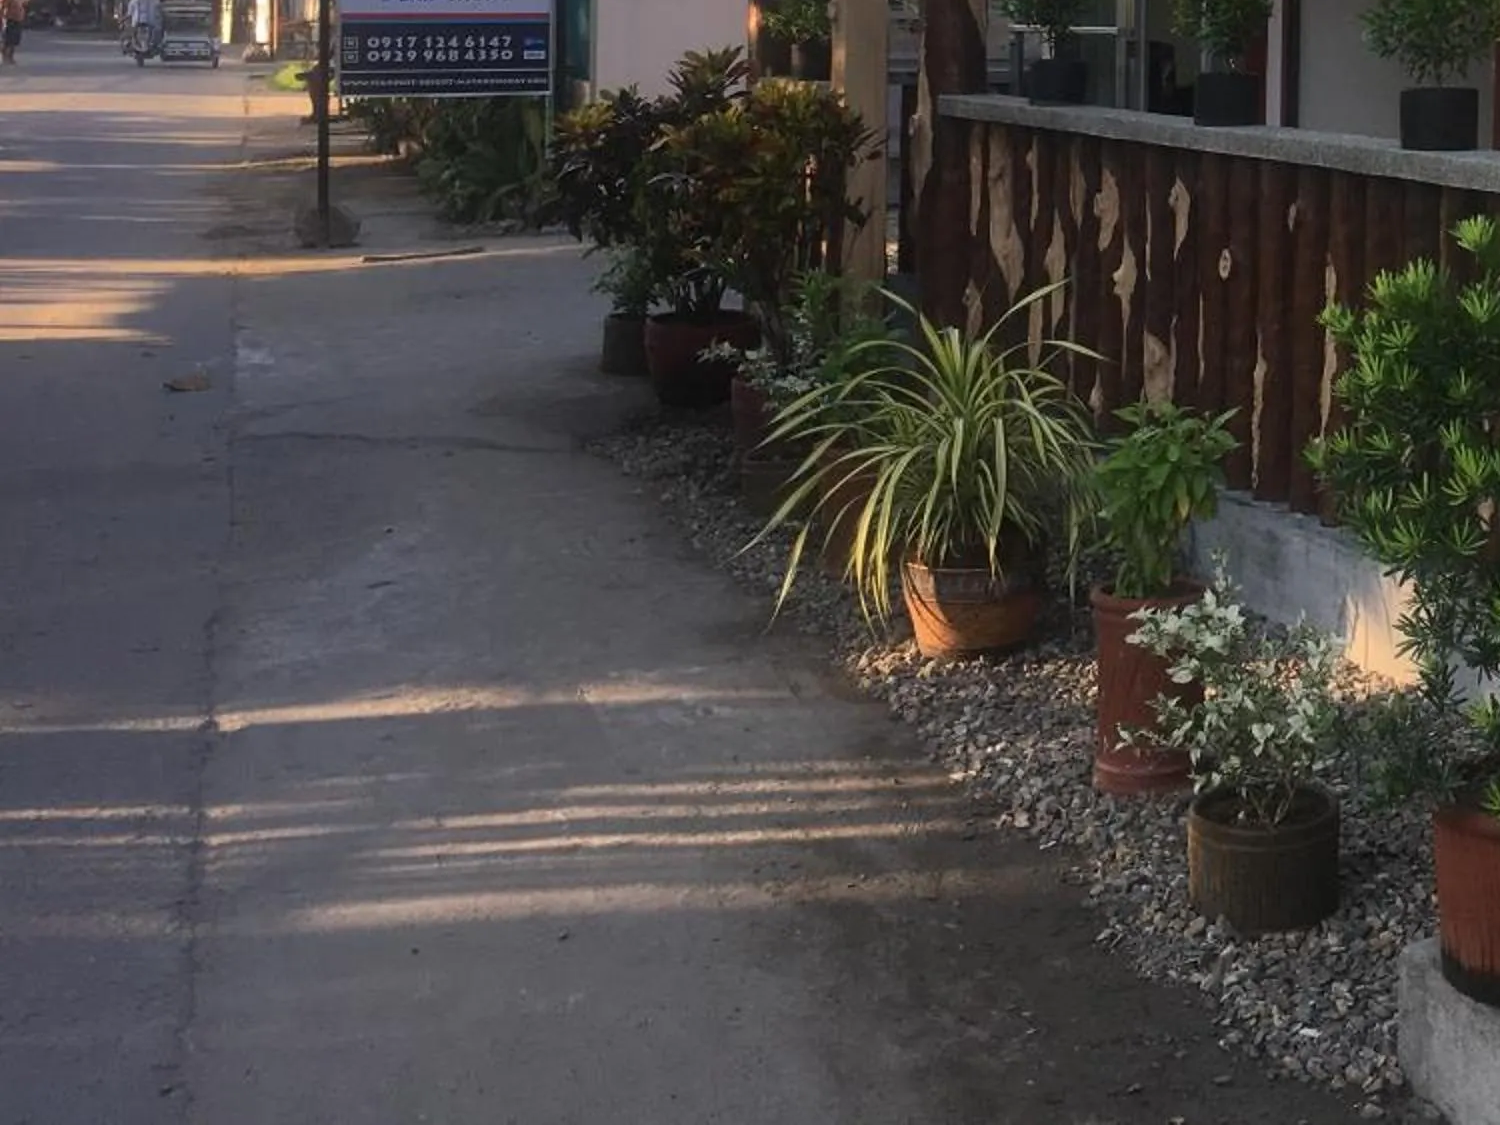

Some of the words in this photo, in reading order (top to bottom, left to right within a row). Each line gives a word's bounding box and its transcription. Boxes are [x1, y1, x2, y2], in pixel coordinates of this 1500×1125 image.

[367, 35, 418, 49] 0917
[464, 35, 512, 49] 6147
[367, 49, 418, 63] 0929
